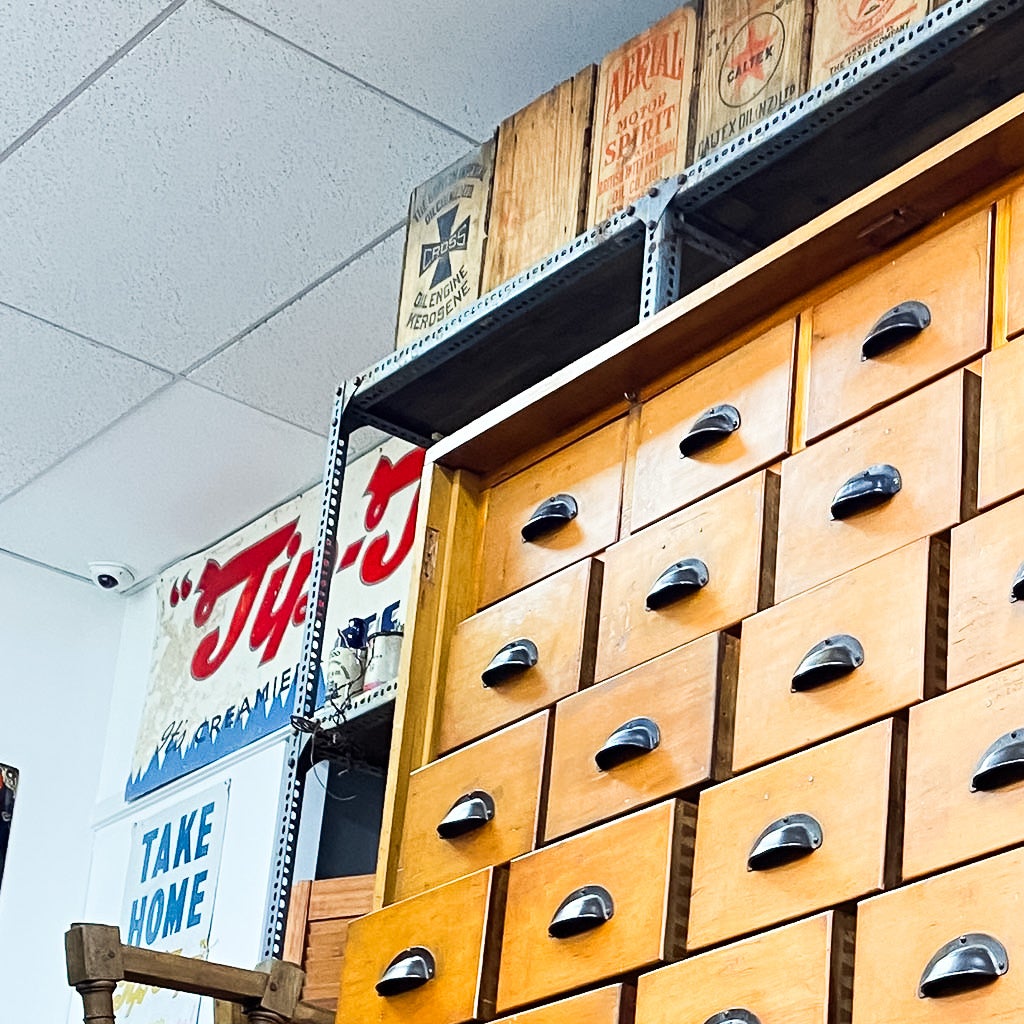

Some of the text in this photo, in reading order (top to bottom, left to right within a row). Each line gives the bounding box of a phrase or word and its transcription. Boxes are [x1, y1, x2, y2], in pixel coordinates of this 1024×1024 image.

[605, 31, 684, 125] AERIAL
[727, 44, 775, 84] CALTEX
[604, 104, 676, 166] SPIRIT
[616, 94, 667, 135] MOTOR
[698, 117, 737, 159] CALTEX
[739, 108, 754, 130] OIL
[422, 224, 467, 271] CROSS
[406, 280, 471, 331] KEROSENE
[429, 264, 468, 309] ENGINE
[140, 801, 215, 883] TAKE
[127, 870, 208, 947] HOME
